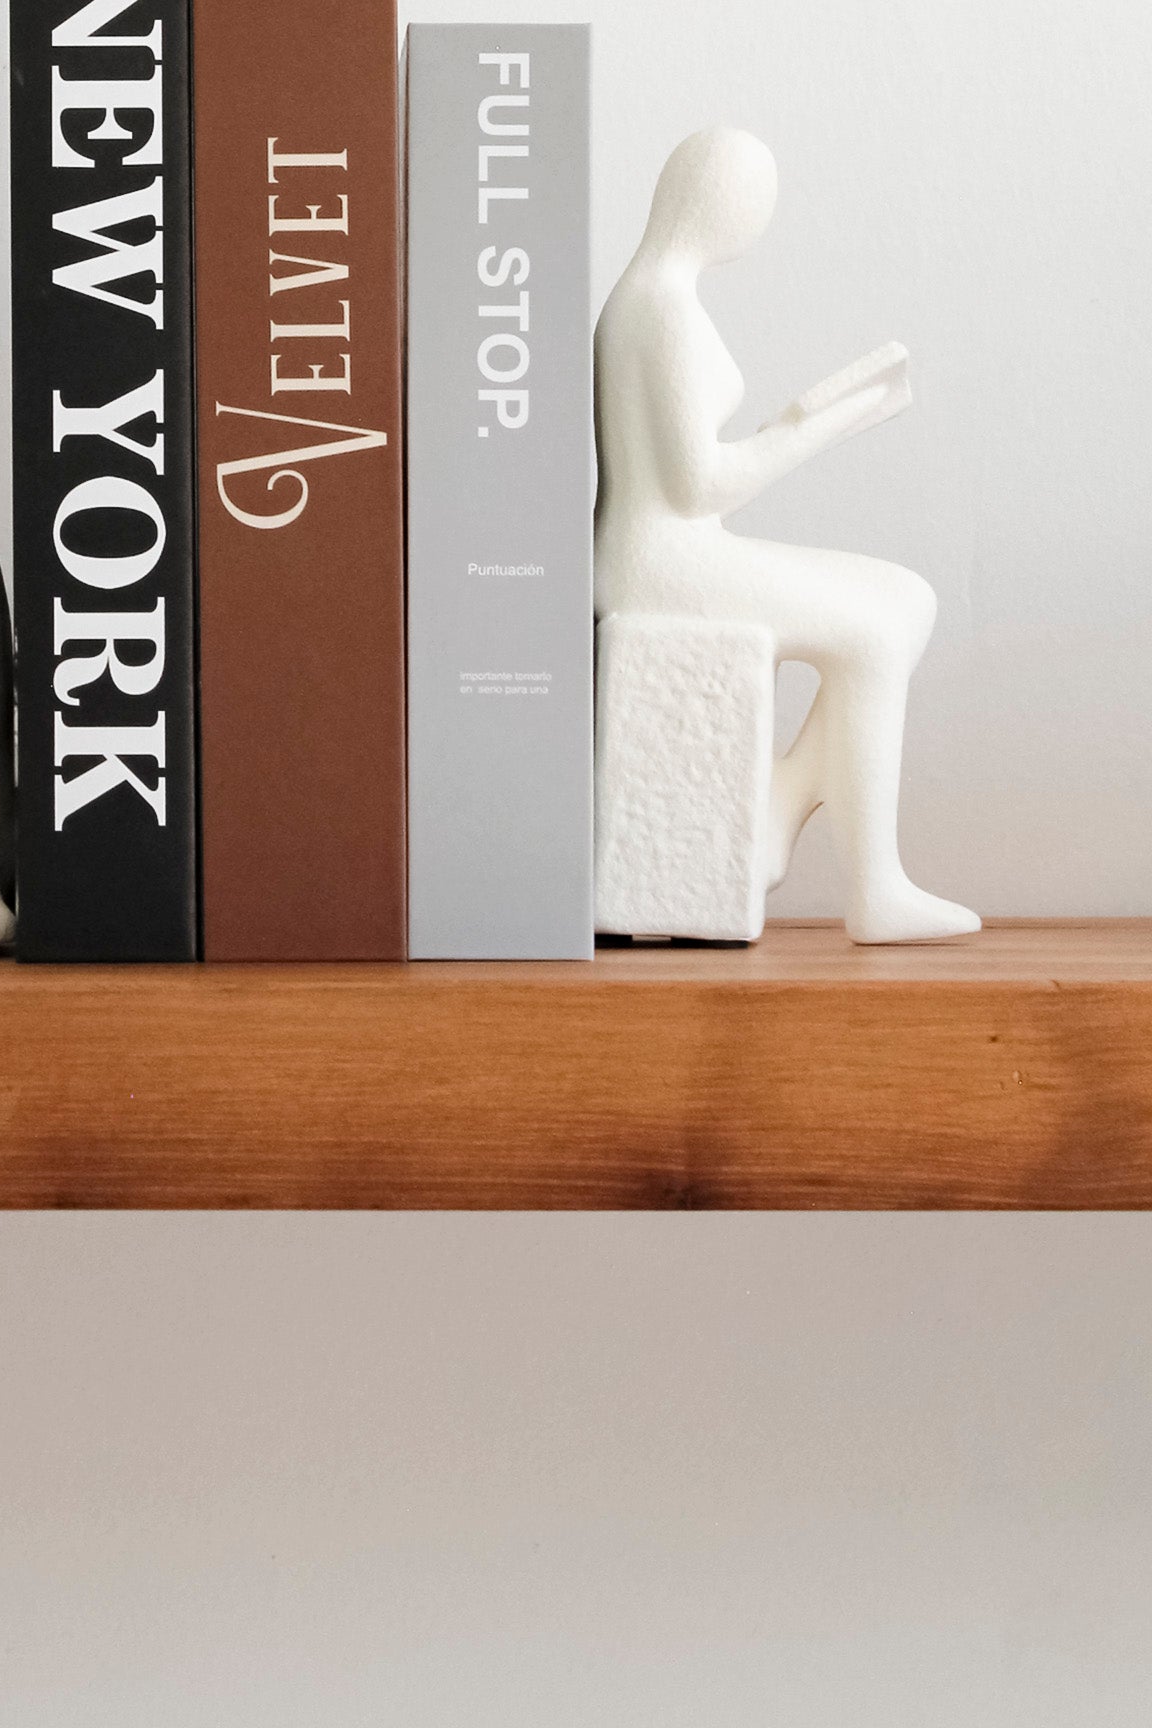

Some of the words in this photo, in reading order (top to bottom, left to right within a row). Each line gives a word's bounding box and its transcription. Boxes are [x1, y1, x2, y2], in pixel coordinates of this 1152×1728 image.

[477, 52, 530, 224] FULL
[215, 136, 388, 530] VELVET
[477, 245, 531, 438] STOP.
[51, 368, 167, 832] YORK
[467, 561, 545, 577] Puntuación
[459, 685, 473, 694] en
[504, 685, 528, 696] para
[529, 685, 549, 695] una
